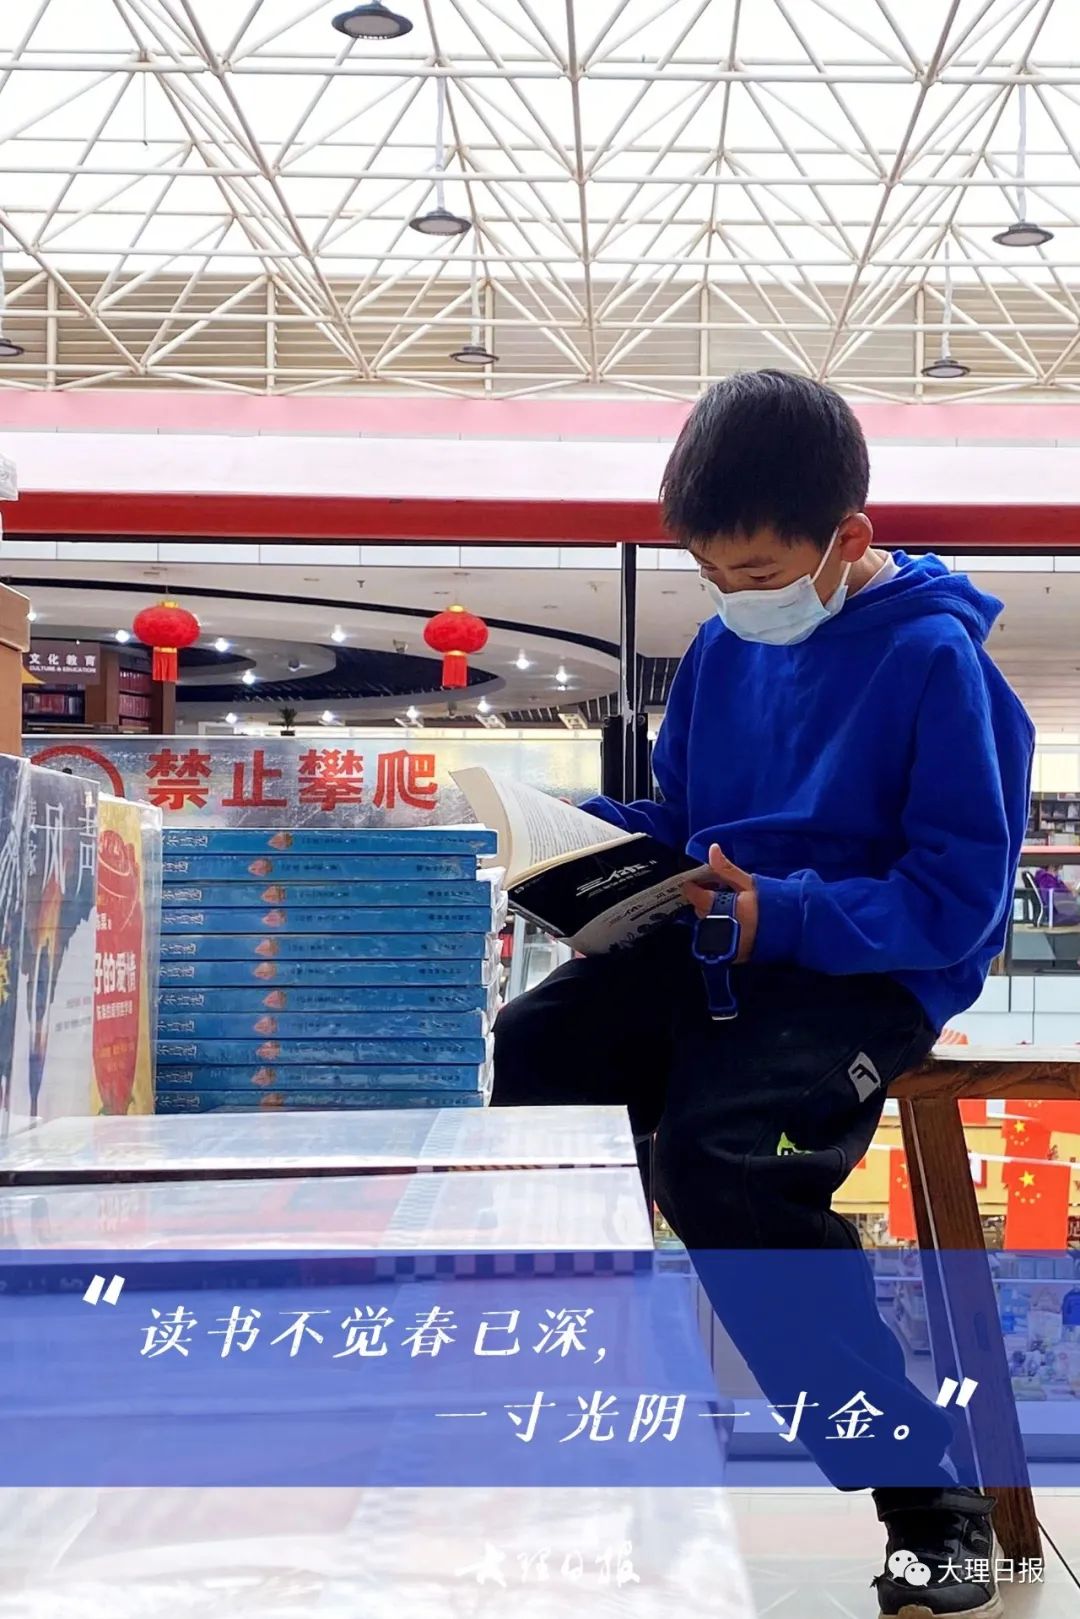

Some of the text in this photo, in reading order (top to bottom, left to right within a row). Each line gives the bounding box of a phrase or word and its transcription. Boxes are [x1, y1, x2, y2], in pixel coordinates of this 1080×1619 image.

[29, 652, 97, 667] 文化教育
[145, 748, 438, 812] 禁止攀爬
